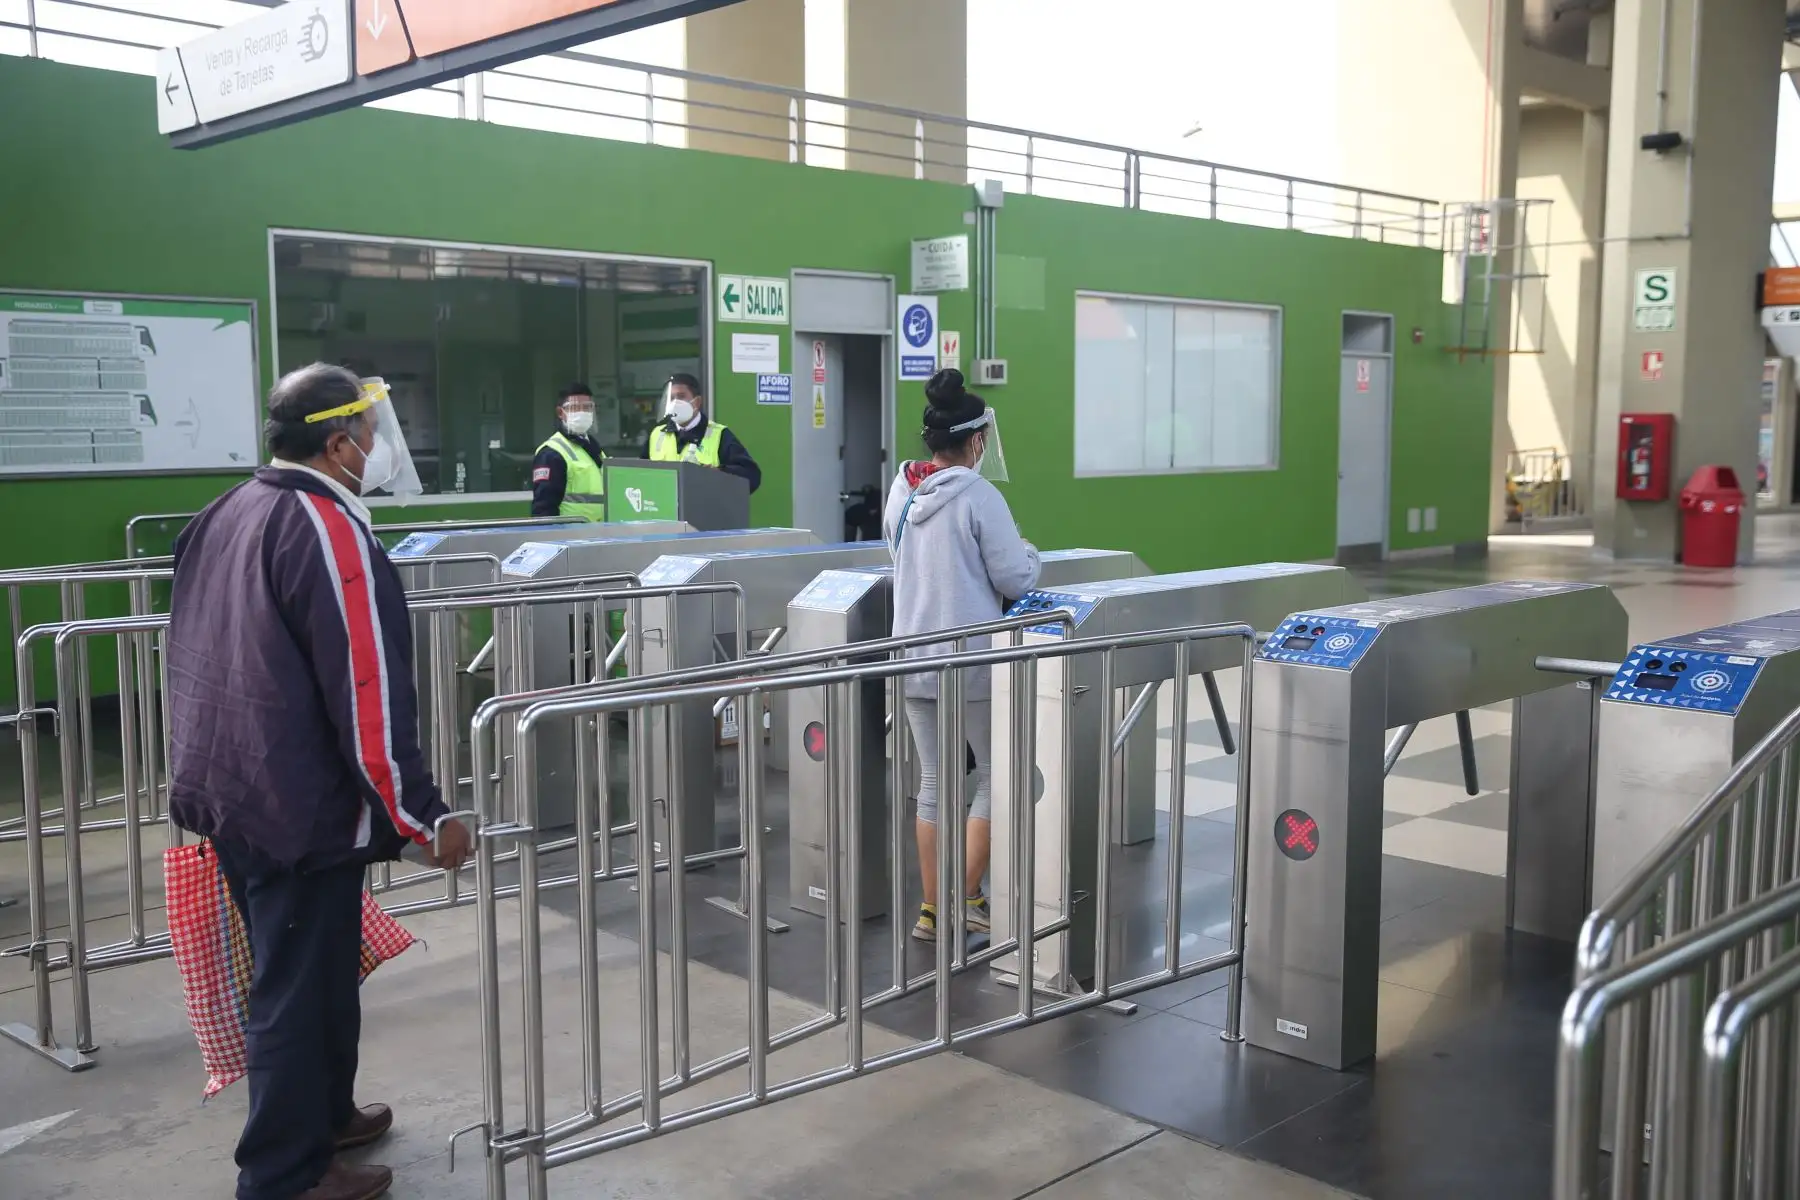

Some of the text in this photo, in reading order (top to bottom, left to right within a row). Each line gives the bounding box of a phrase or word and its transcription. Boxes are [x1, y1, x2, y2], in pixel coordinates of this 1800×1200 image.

[205, 28, 288, 71] Venta y Recarga
[219, 64, 274, 96] de Tarjetas
[928, 241, 953, 253] CUIDA
[747, 284, 784, 316] SALIDA
[1644, 275, 1668, 302] S
[760, 375, 789, 386] AFORO
